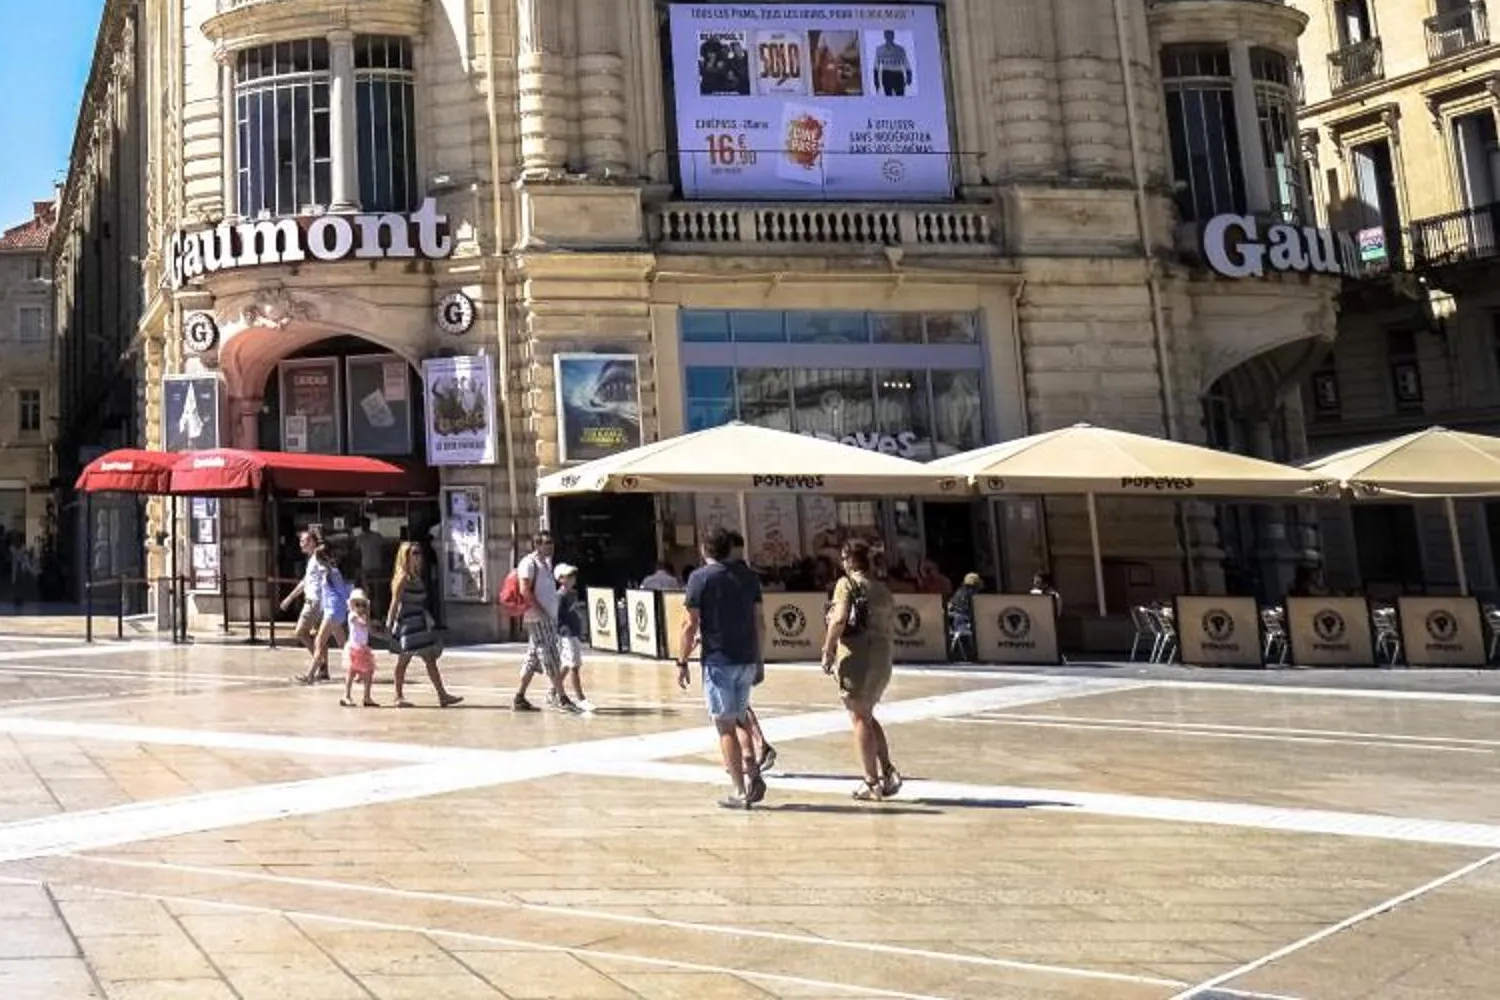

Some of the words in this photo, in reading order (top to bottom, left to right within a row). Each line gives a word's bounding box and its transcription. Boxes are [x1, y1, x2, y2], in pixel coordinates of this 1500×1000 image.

[760, 43, 800, 81] SOLO
[706, 134, 735, 165] 16
[169, 198, 450, 290] Gaumont
[445, 301, 464, 325] G
[191, 321, 206, 342] G
